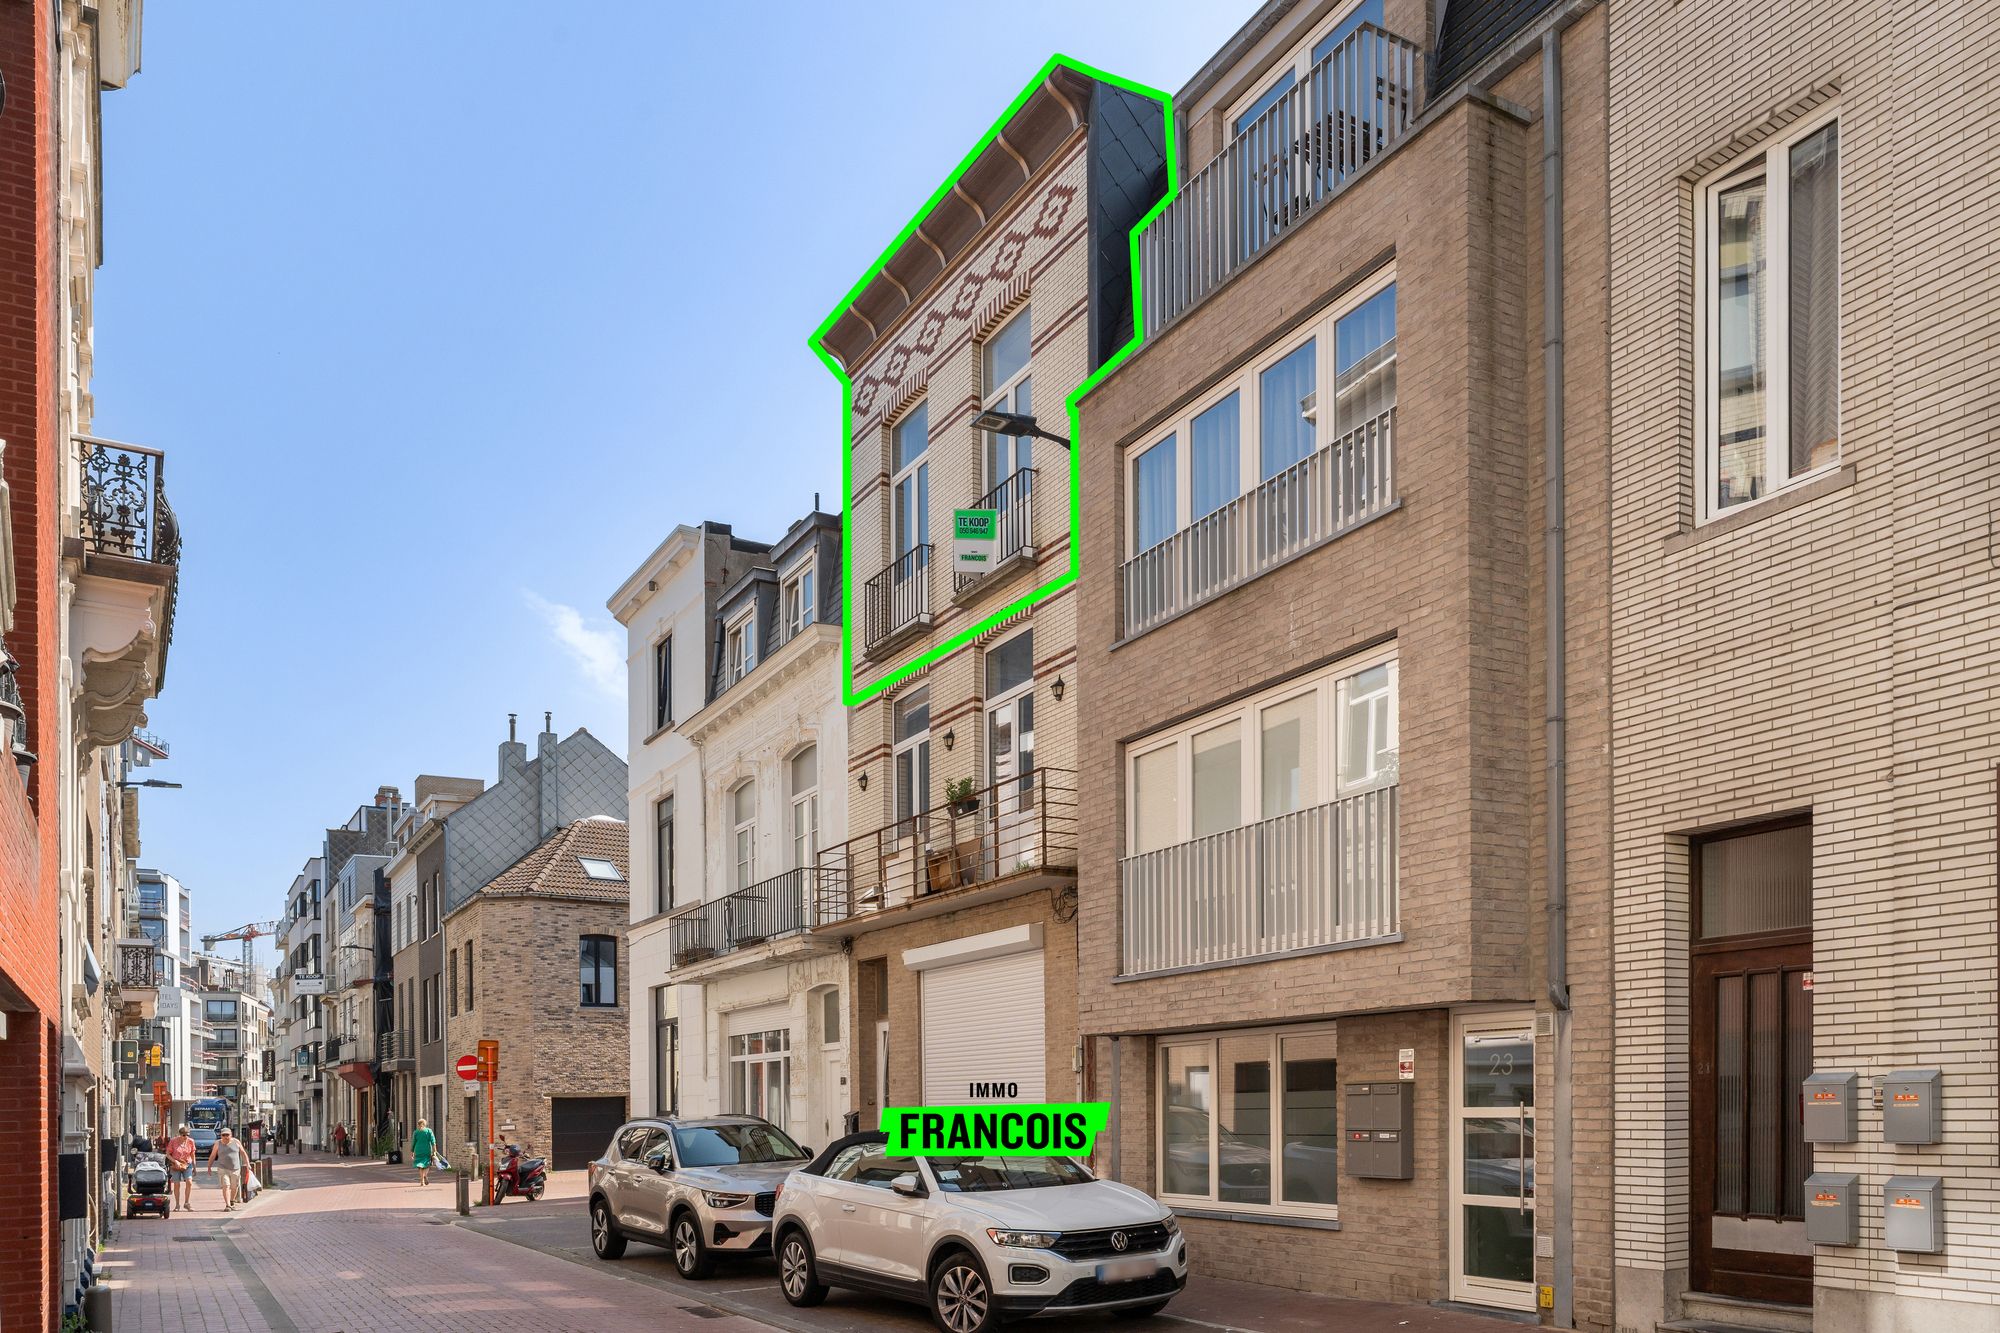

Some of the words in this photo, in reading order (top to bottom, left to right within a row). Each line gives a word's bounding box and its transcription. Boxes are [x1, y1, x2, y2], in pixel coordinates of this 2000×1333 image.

[958, 517, 967, 527] TE
[968, 517, 989, 527] KOOP
[960, 554, 987, 562] FRANCOIS
[1488, 1053, 1514, 1076] 23
